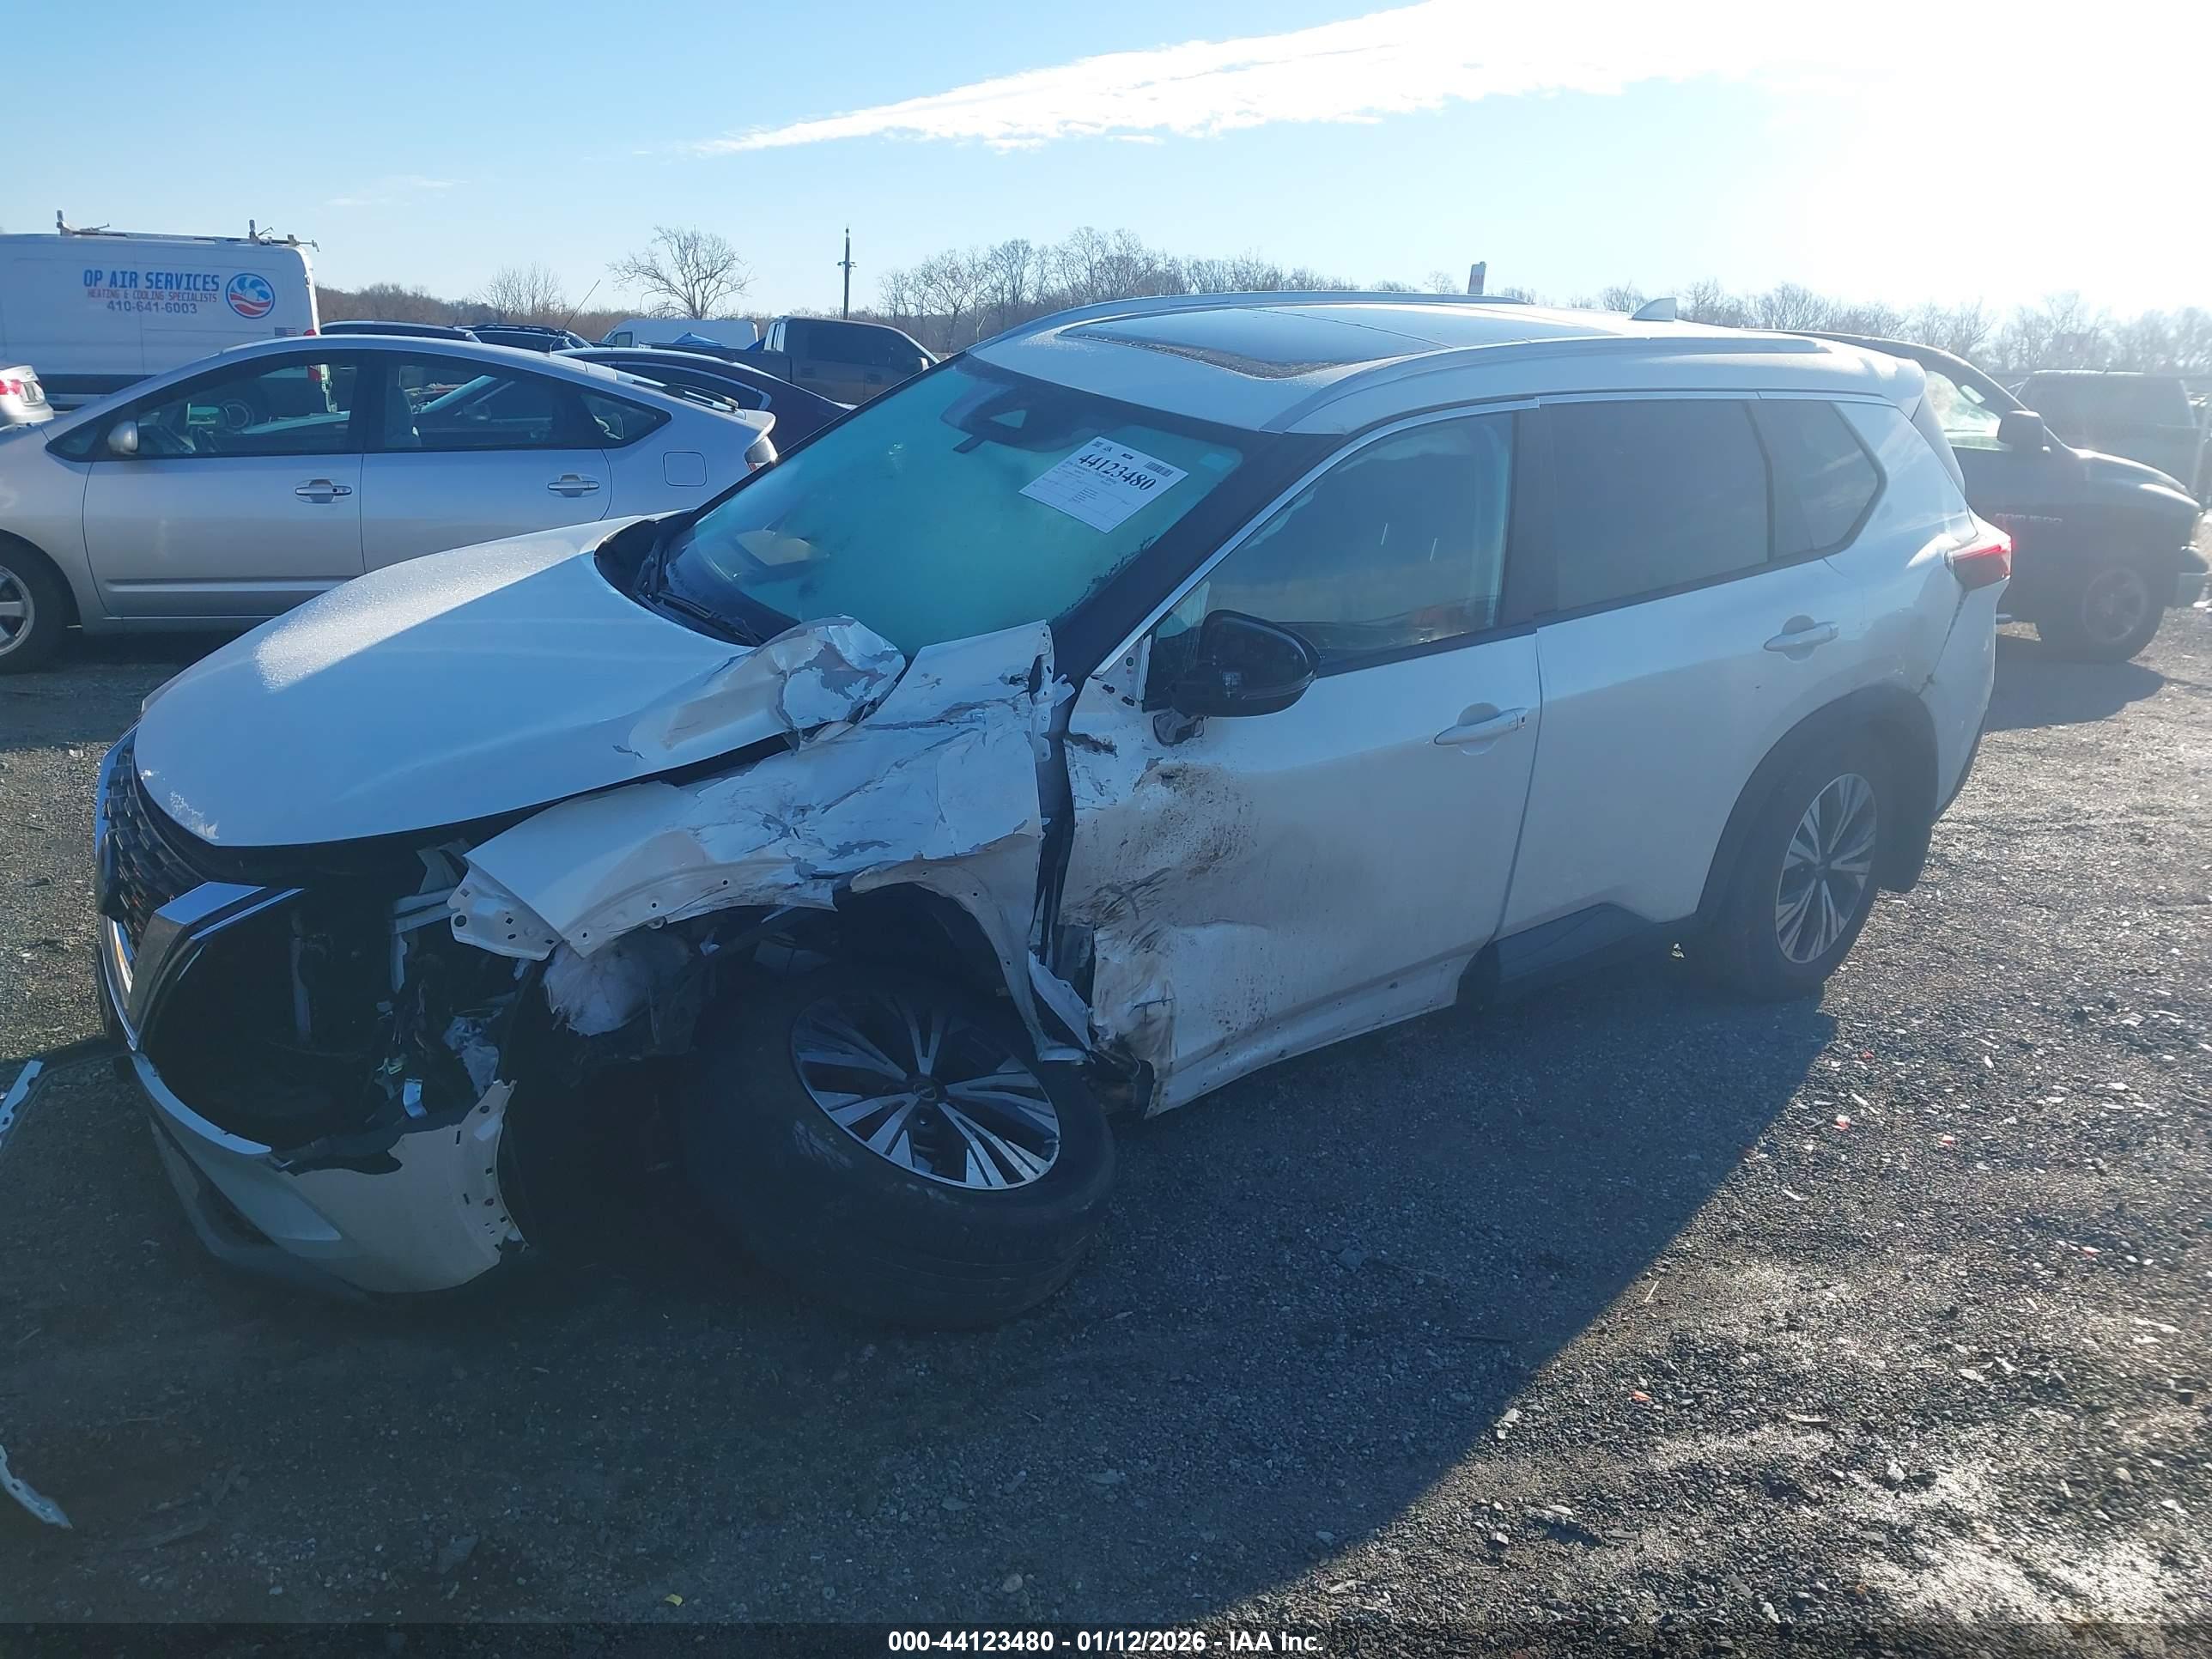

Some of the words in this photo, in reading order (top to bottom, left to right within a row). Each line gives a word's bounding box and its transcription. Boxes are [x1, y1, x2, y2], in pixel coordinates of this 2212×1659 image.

[84, 270, 103, 287] OP
[109, 270, 138, 289] AIR
[145, 272, 220, 291] SERVICES
[88, 289, 119, 299] HEATING
[133, 290, 164, 301] COOLING
[168, 291, 217, 302] SPECIALISTS
[106, 301, 198, 313] 410-641-6003
[1079, 453, 1157, 491] 44123480
